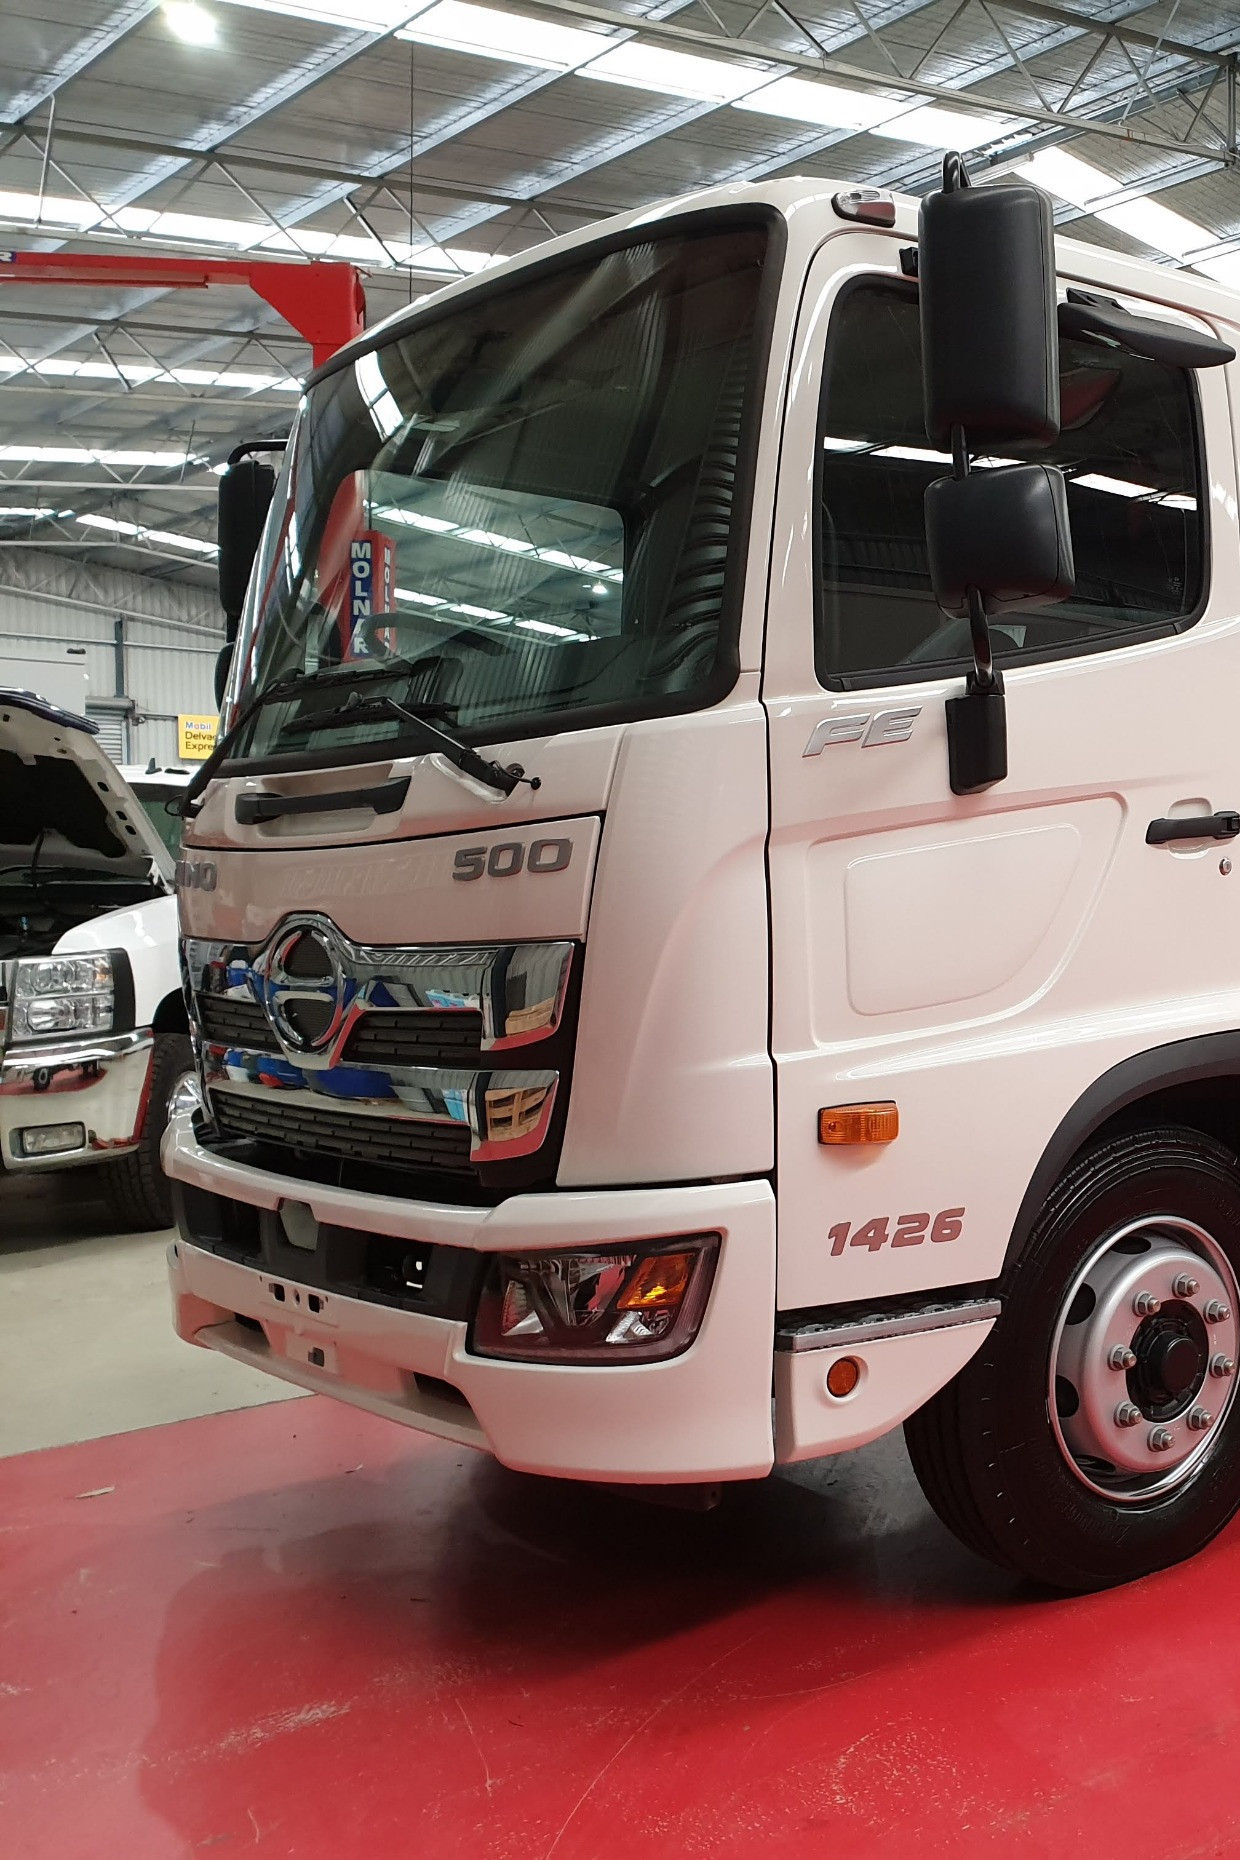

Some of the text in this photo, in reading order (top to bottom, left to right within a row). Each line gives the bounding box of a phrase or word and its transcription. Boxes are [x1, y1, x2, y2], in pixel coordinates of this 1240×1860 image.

[185, 721, 211, 730] Mobil
[802, 705, 923, 758] FE
[185, 741, 214, 752] Expre
[175, 860, 218, 892] INO
[452, 838, 574, 882] 500
[828, 1207, 965, 1257] 1426
